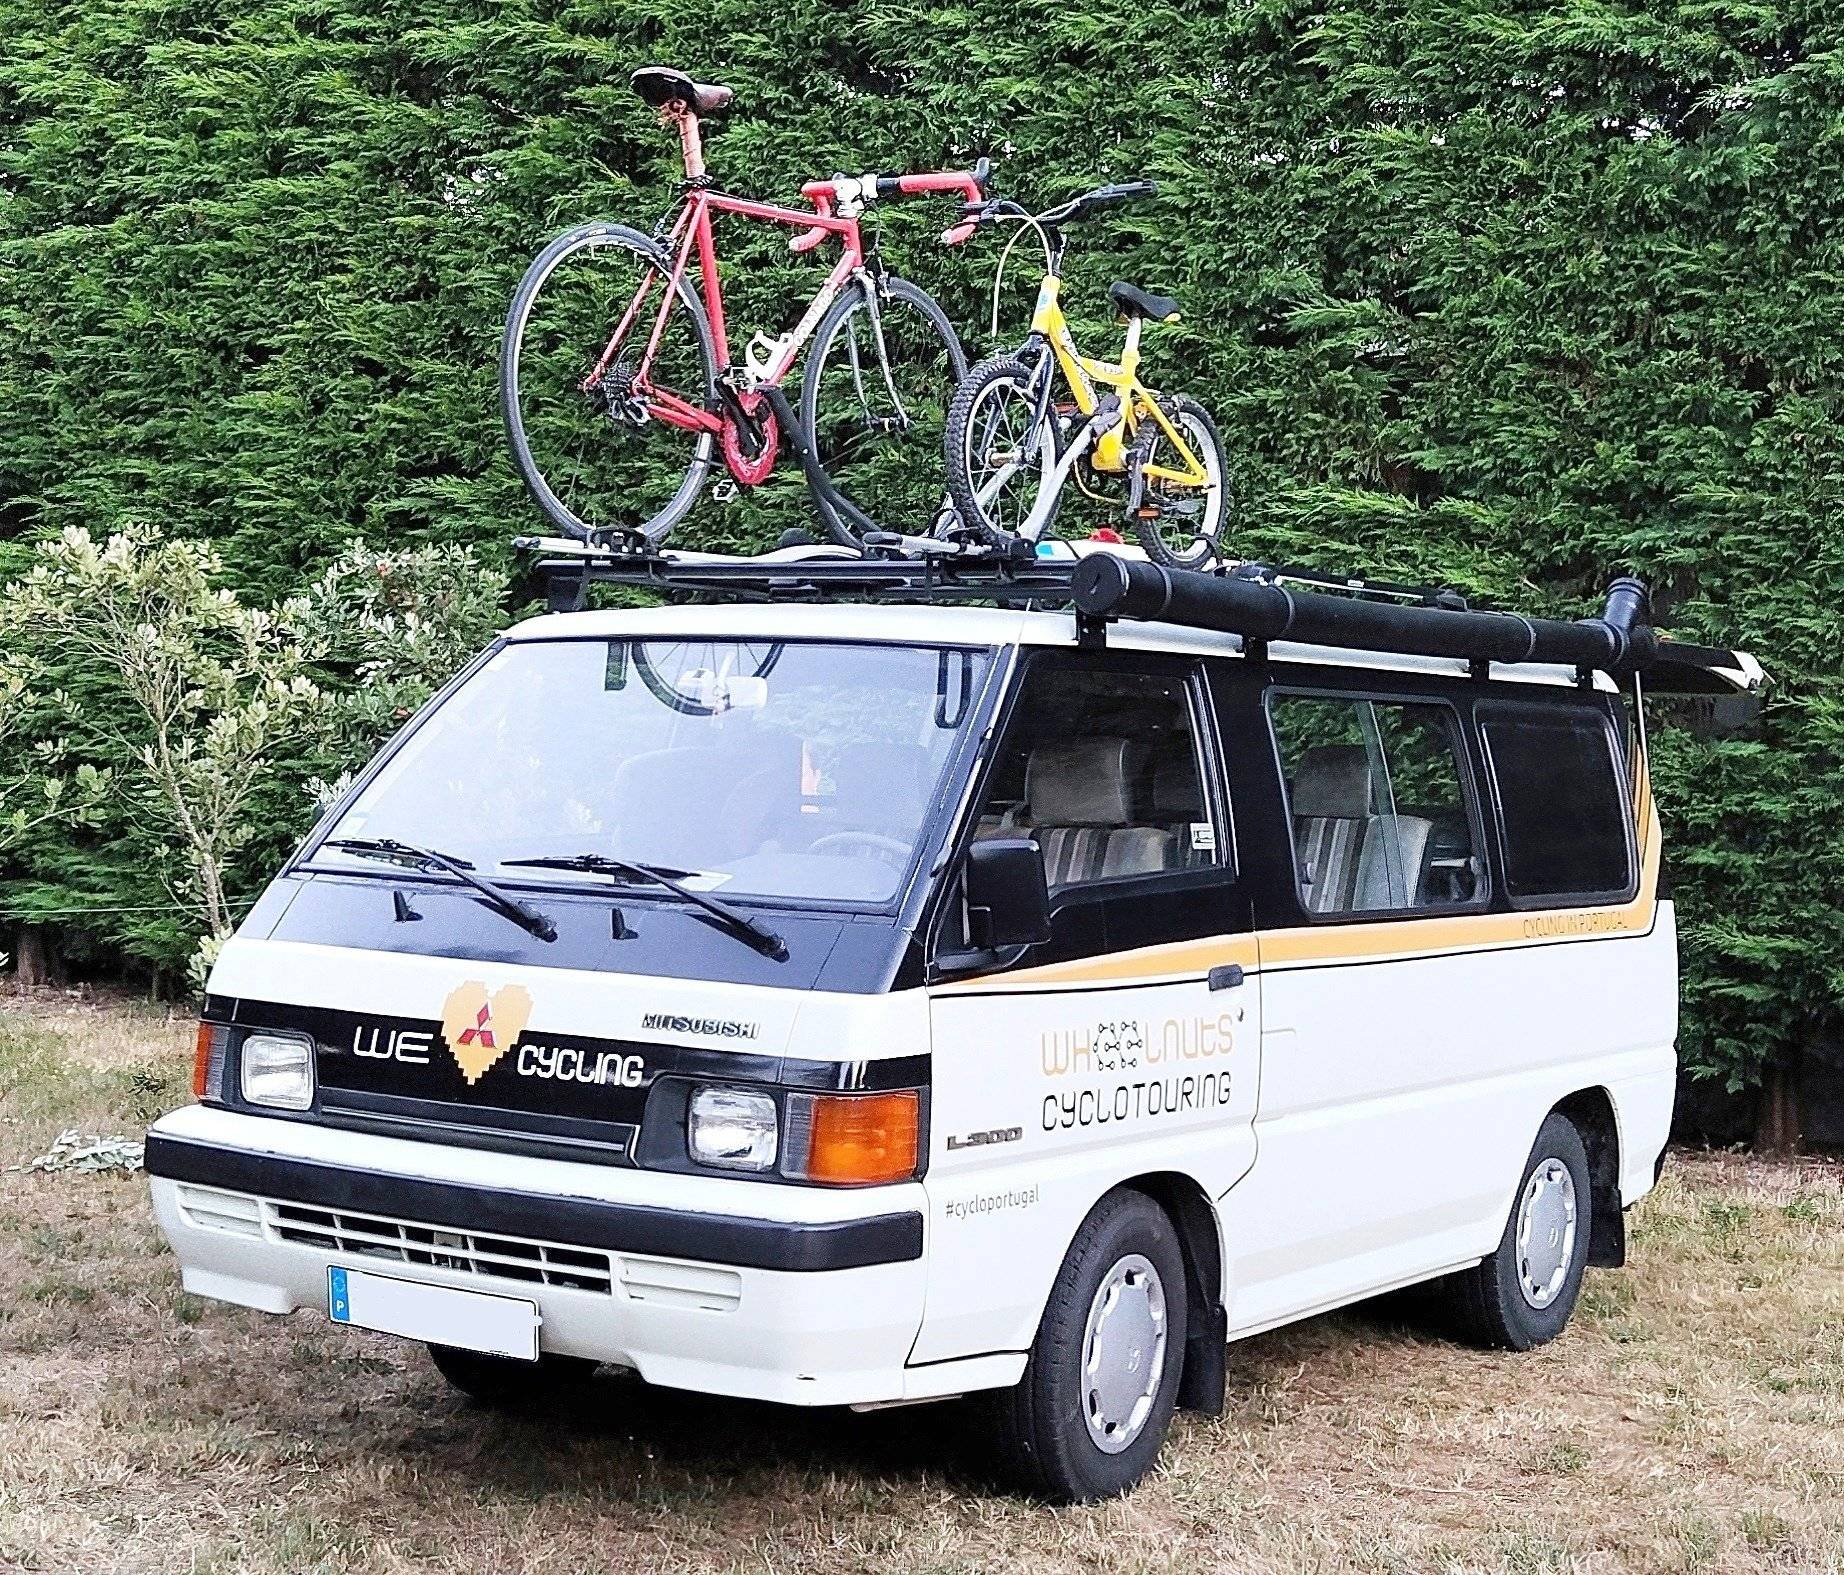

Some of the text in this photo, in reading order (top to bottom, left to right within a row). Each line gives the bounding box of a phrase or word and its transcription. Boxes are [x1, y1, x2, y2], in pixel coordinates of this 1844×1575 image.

[641, 1012, 760, 1040] MITSUBISHI
[353, 1026, 644, 1087] WE CYCLING
[1041, 1071, 1232, 1132] CYCLOTOURING
[946, 1126, 1023, 1151] L300
[945, 1183, 1039, 1220] #cycloportugal
[335, 1299, 345, 1312] P
